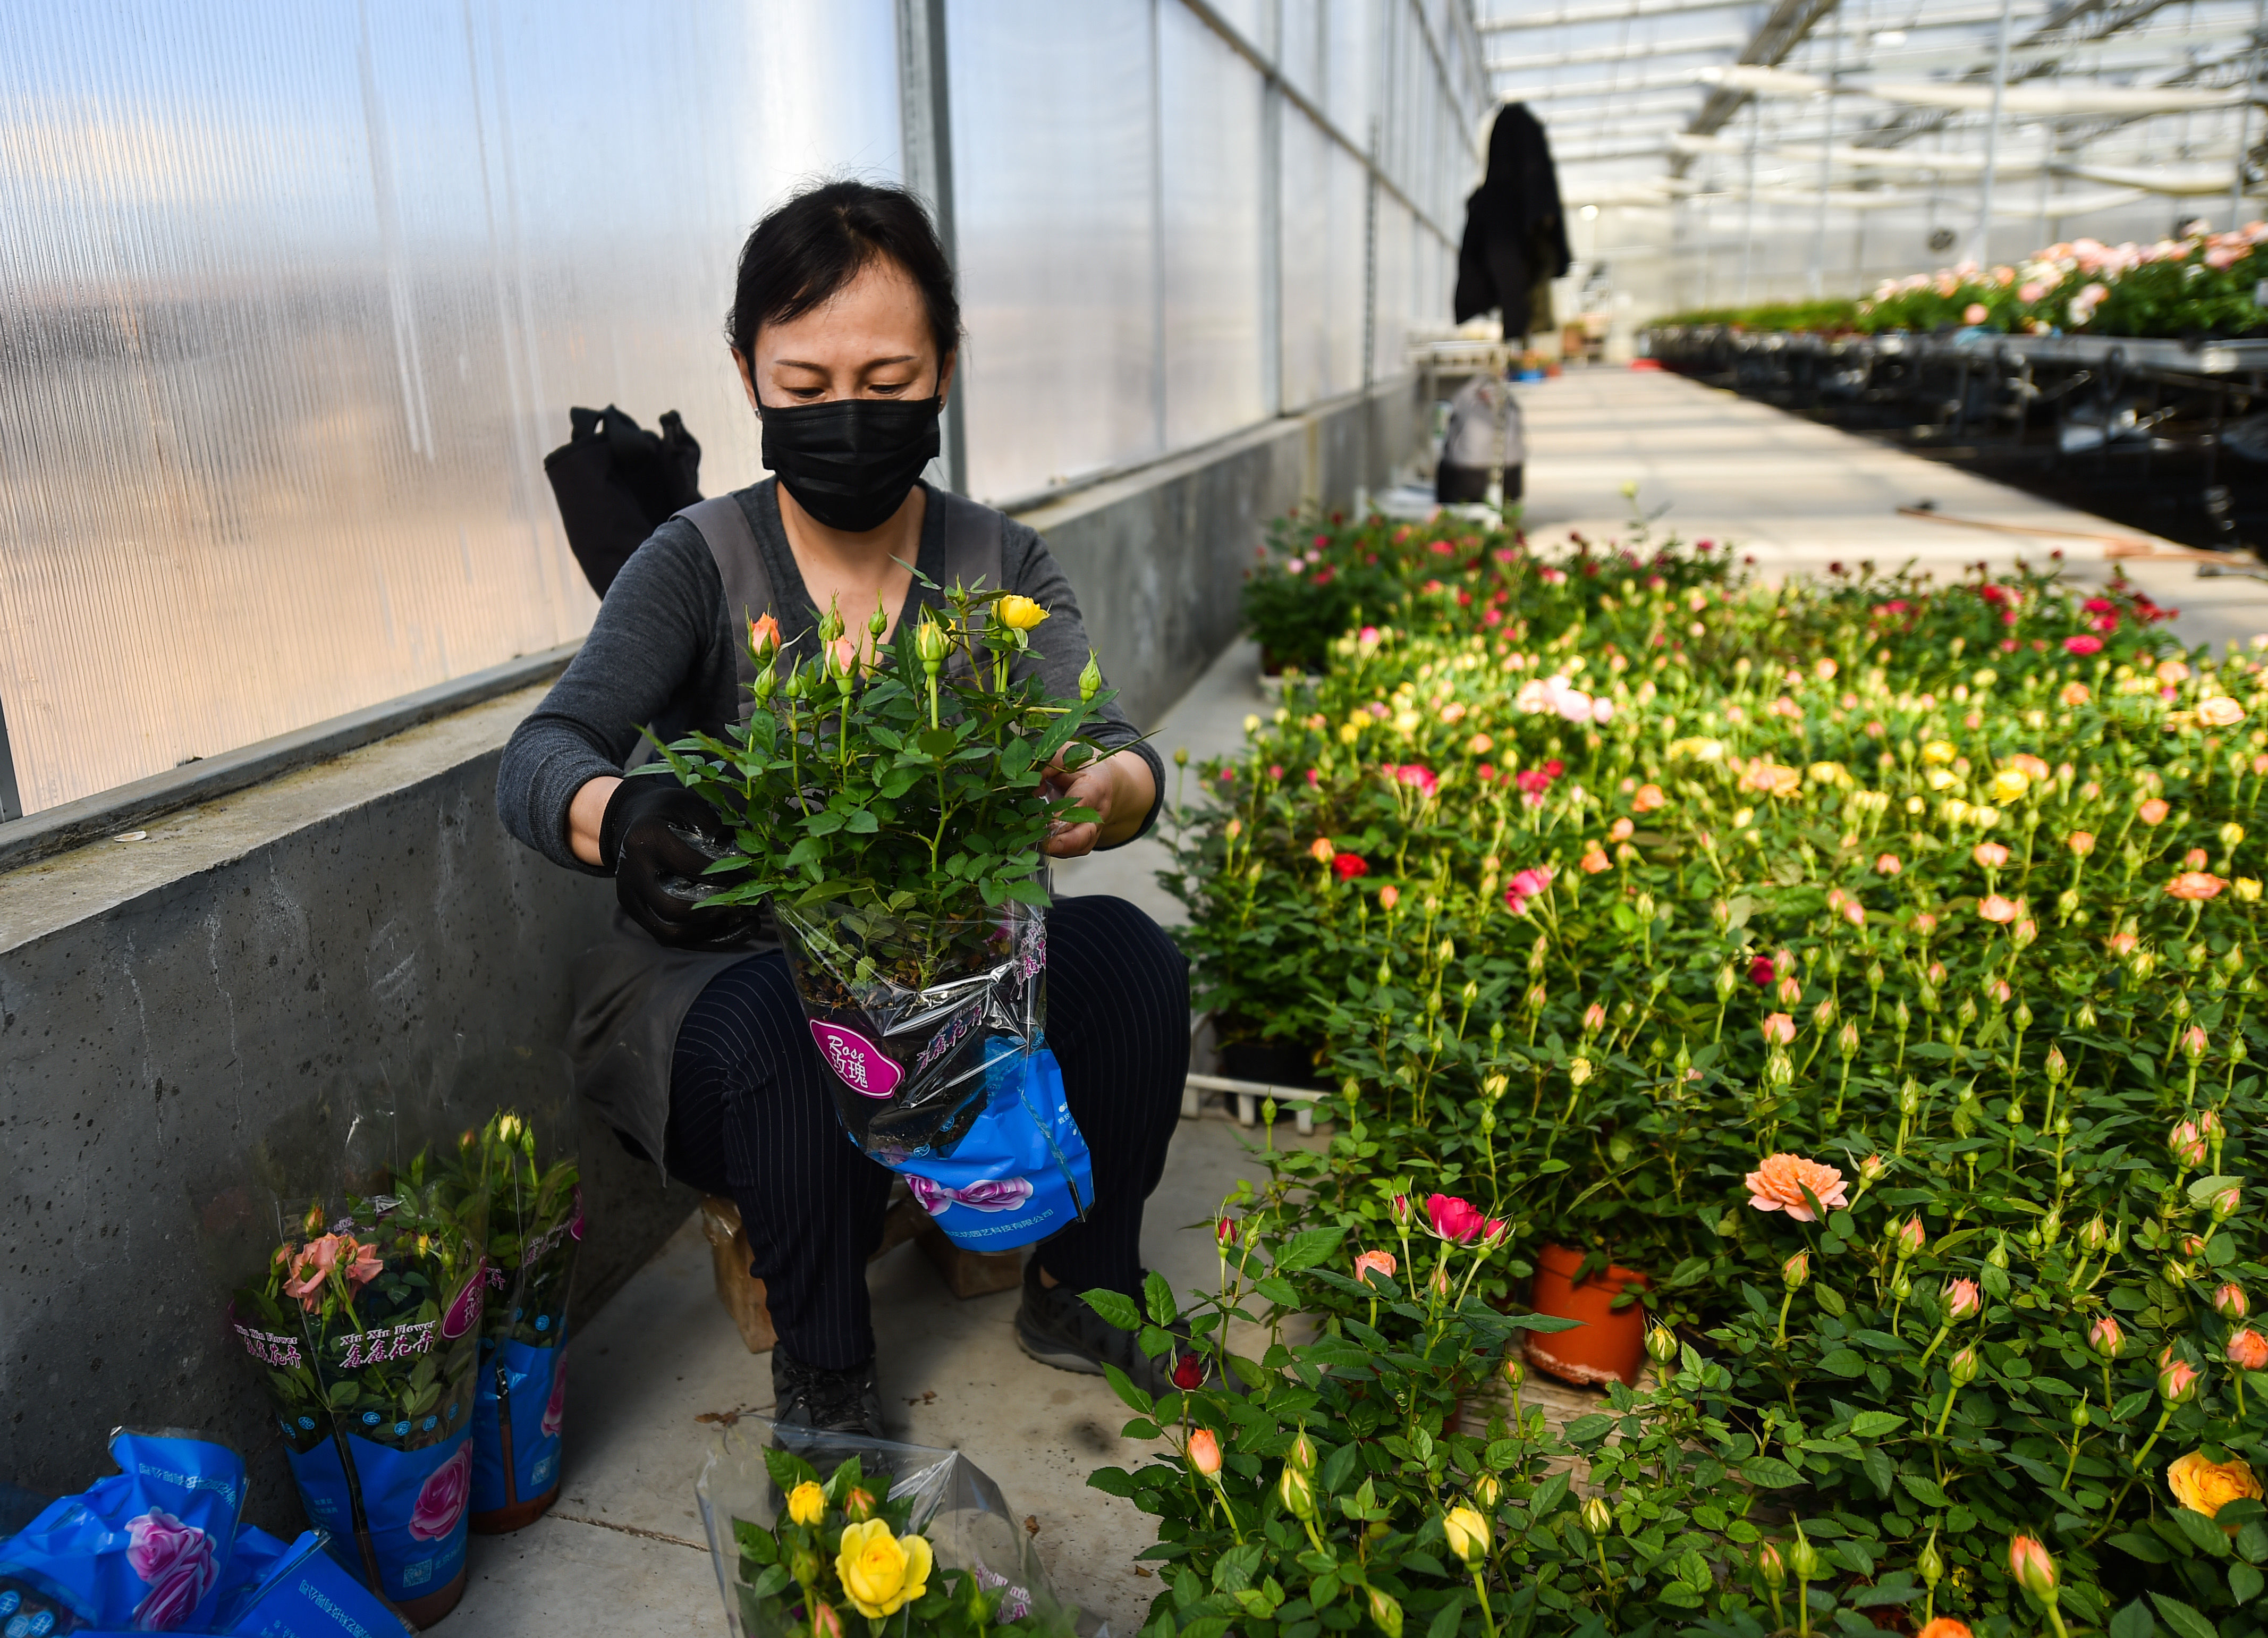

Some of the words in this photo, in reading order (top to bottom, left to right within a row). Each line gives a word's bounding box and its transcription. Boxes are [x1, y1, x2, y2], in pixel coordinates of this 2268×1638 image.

[827, 1035, 865, 1062] Rose
[830, 1050, 868, 1088] 玫瑰
[249, 1329, 266, 1340] Xin
[265, 1332, 298, 1345] Flower
[341, 1333, 363, 1346] Xin
[366, 1329, 391, 1340] Xin
[394, 1320, 436, 1335] Flower
[339, 1330, 434, 1368] 鑫鑫花卉
